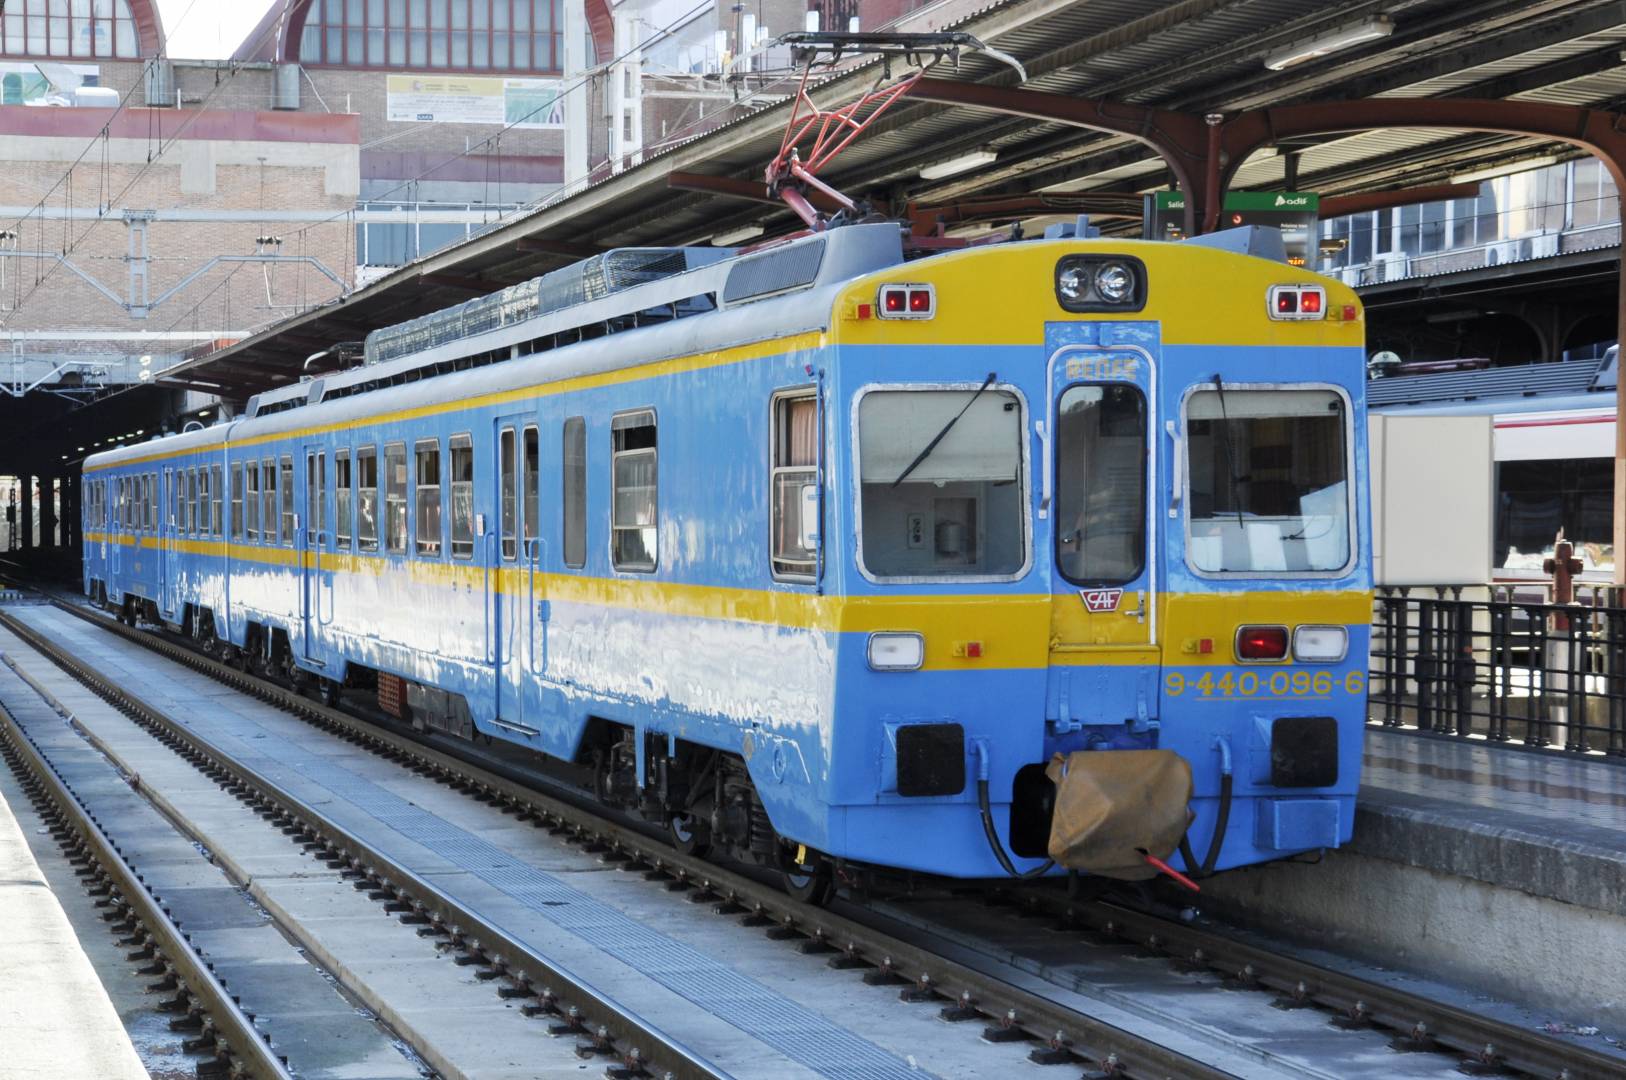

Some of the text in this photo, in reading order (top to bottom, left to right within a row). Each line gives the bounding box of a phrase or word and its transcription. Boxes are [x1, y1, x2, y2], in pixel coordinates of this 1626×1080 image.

[1286, 197, 1308, 205] adif
[1087, 591, 1120, 609] CAF
[1165, 671, 1364, 697] 9-440-096-6
